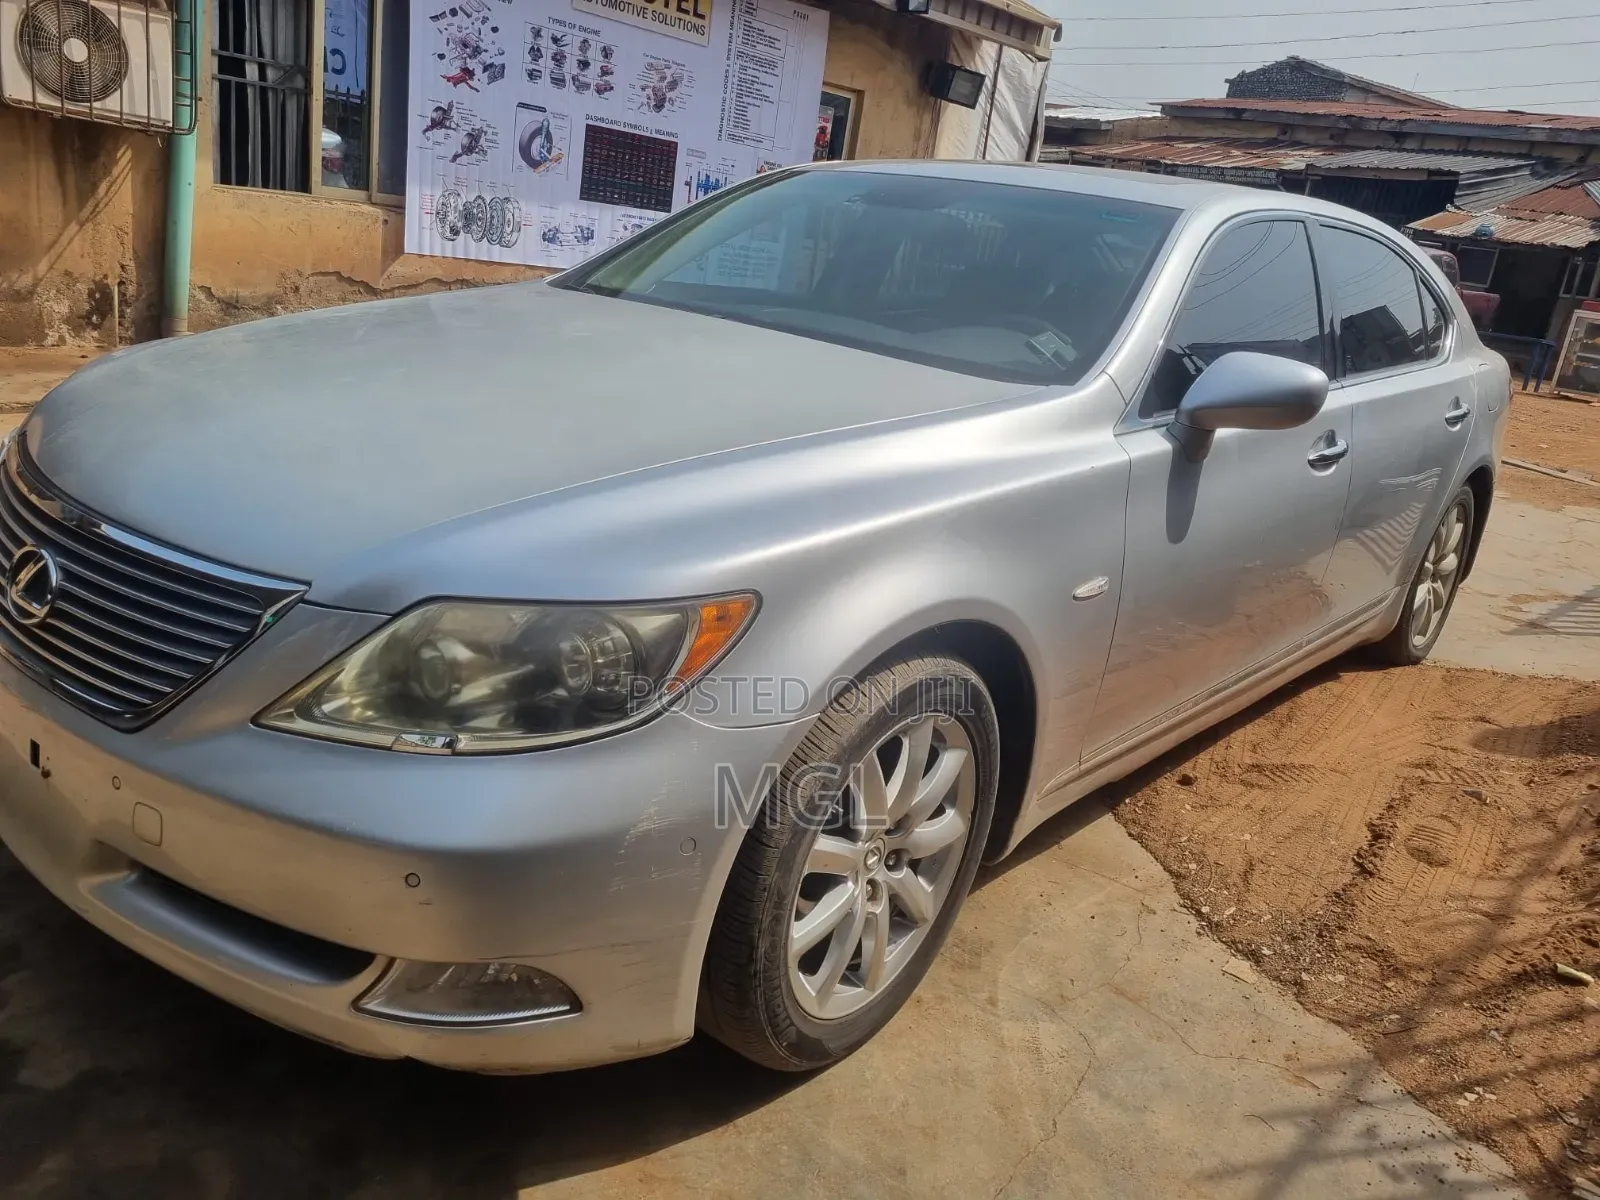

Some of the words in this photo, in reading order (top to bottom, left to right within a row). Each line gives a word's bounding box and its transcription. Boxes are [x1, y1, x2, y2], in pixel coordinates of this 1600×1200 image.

[548, 16, 567, 28] TYPES
[568, 22, 577, 30] OF
[578, 25, 601, 37] ENGINE
[583, 0, 649, 19] OMOTIVE
[651, 10, 706, 36] SOLUTIONS
[586, 113, 622, 127] DASHBOARD
[623, 121, 649, 133] SYMBOLS
[655, 128, 679, 139] MEANING
[718, 96, 727, 141] DIAGNOSTIC
